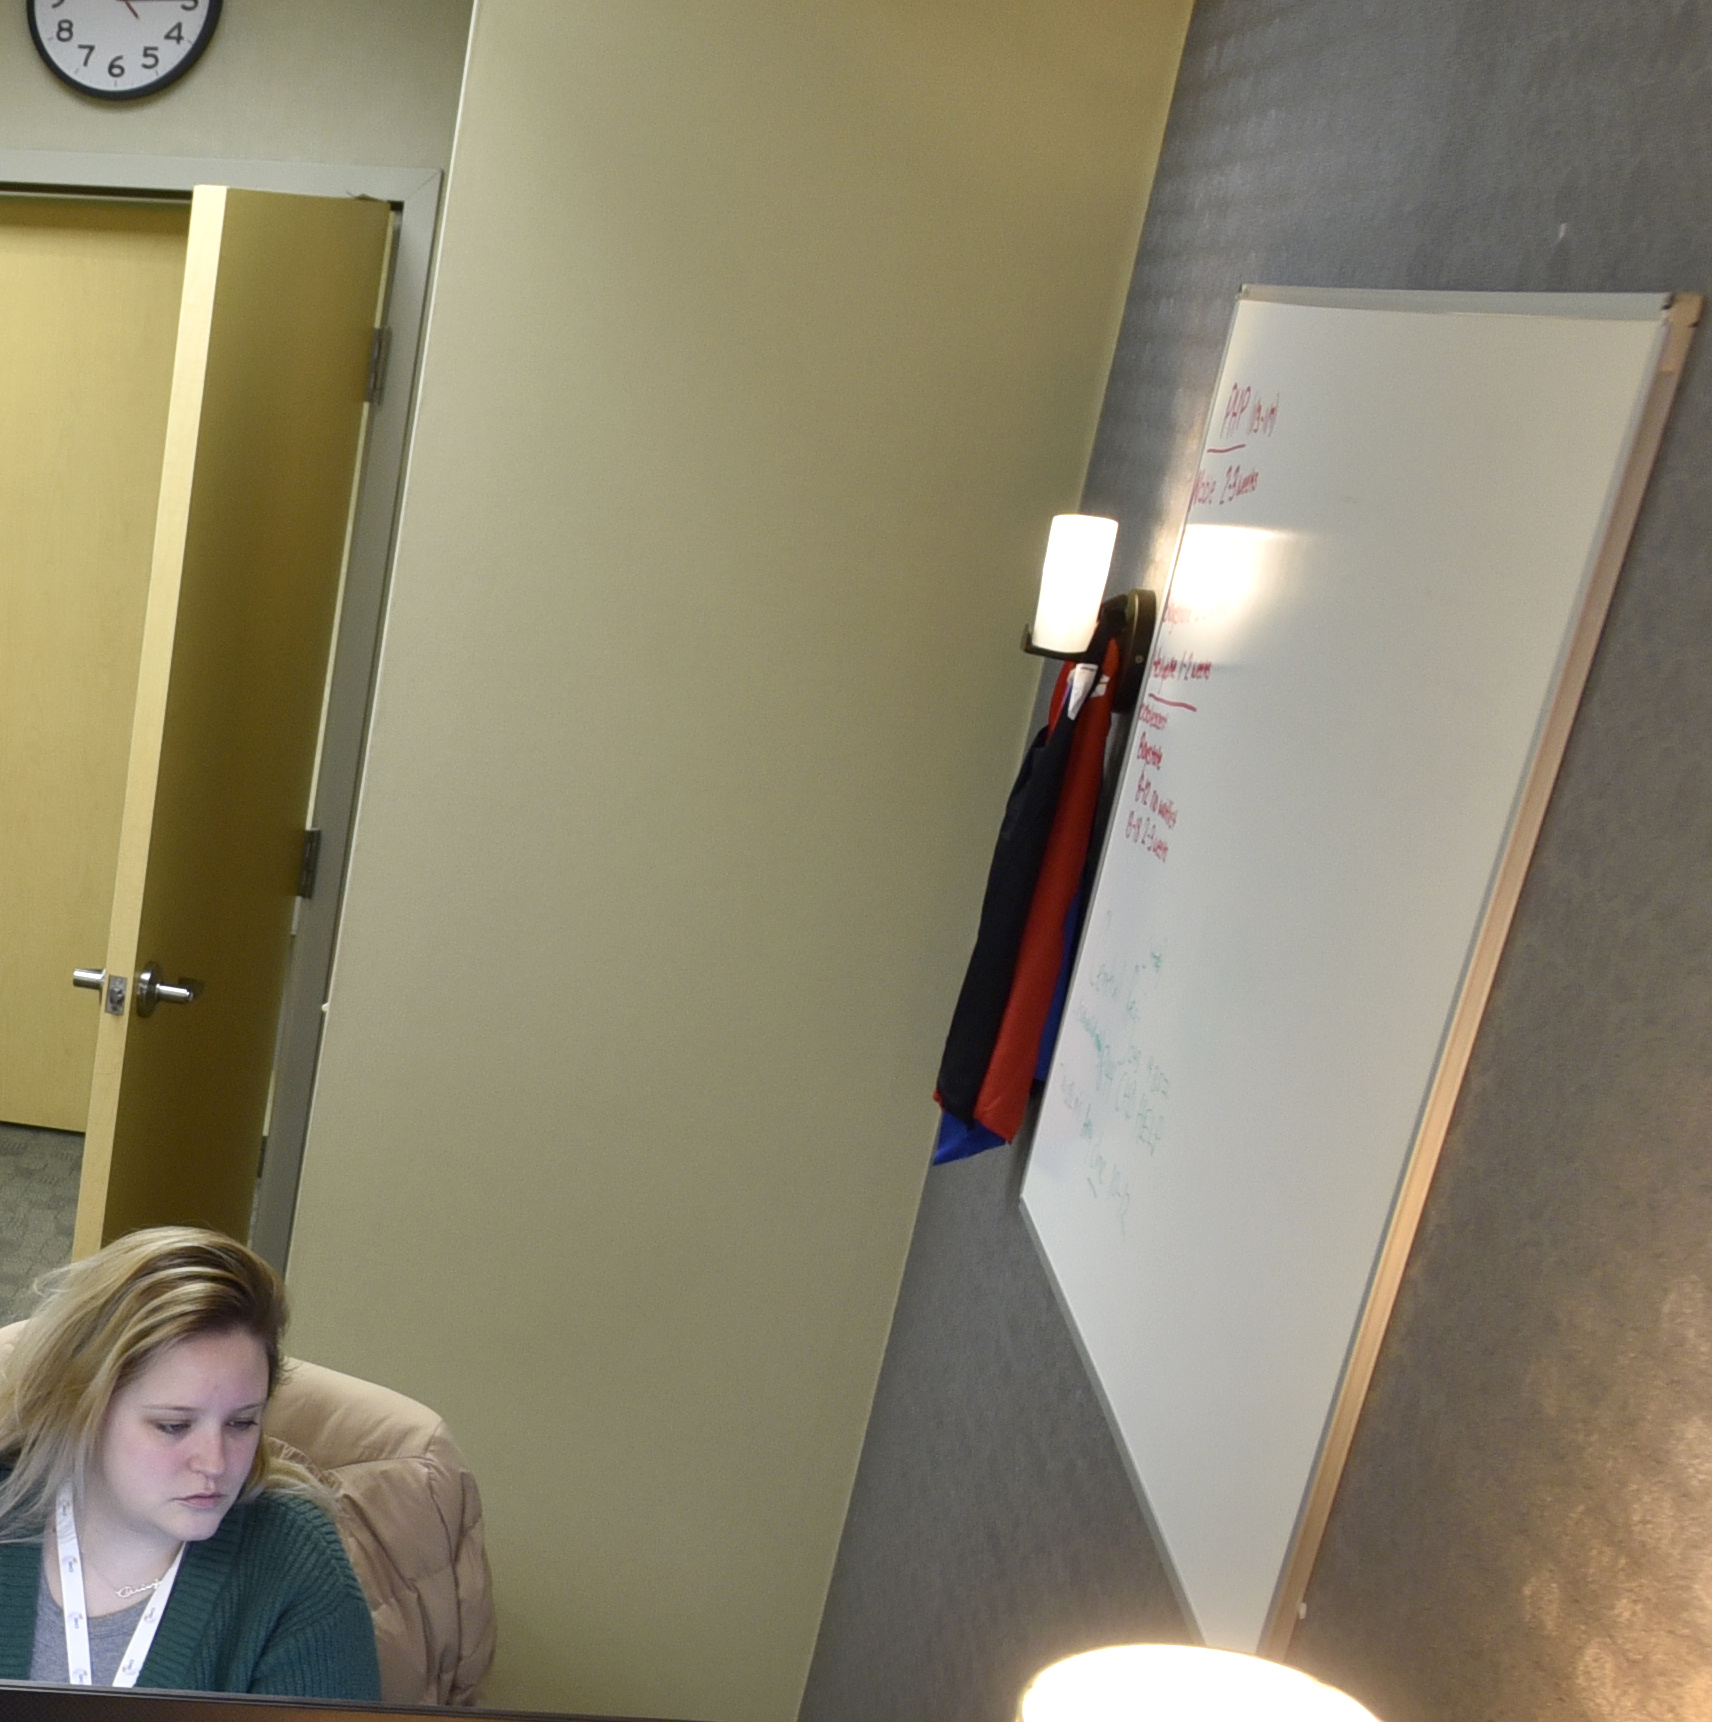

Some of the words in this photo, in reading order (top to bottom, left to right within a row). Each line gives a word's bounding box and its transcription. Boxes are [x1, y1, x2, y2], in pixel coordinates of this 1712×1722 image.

[56, 19, 73, 42] 8
[164, 22, 184, 44] 4
[78, 45, 95, 67] 7
[108, 55, 125, 78] 6
[141, 47, 159, 69] 5
